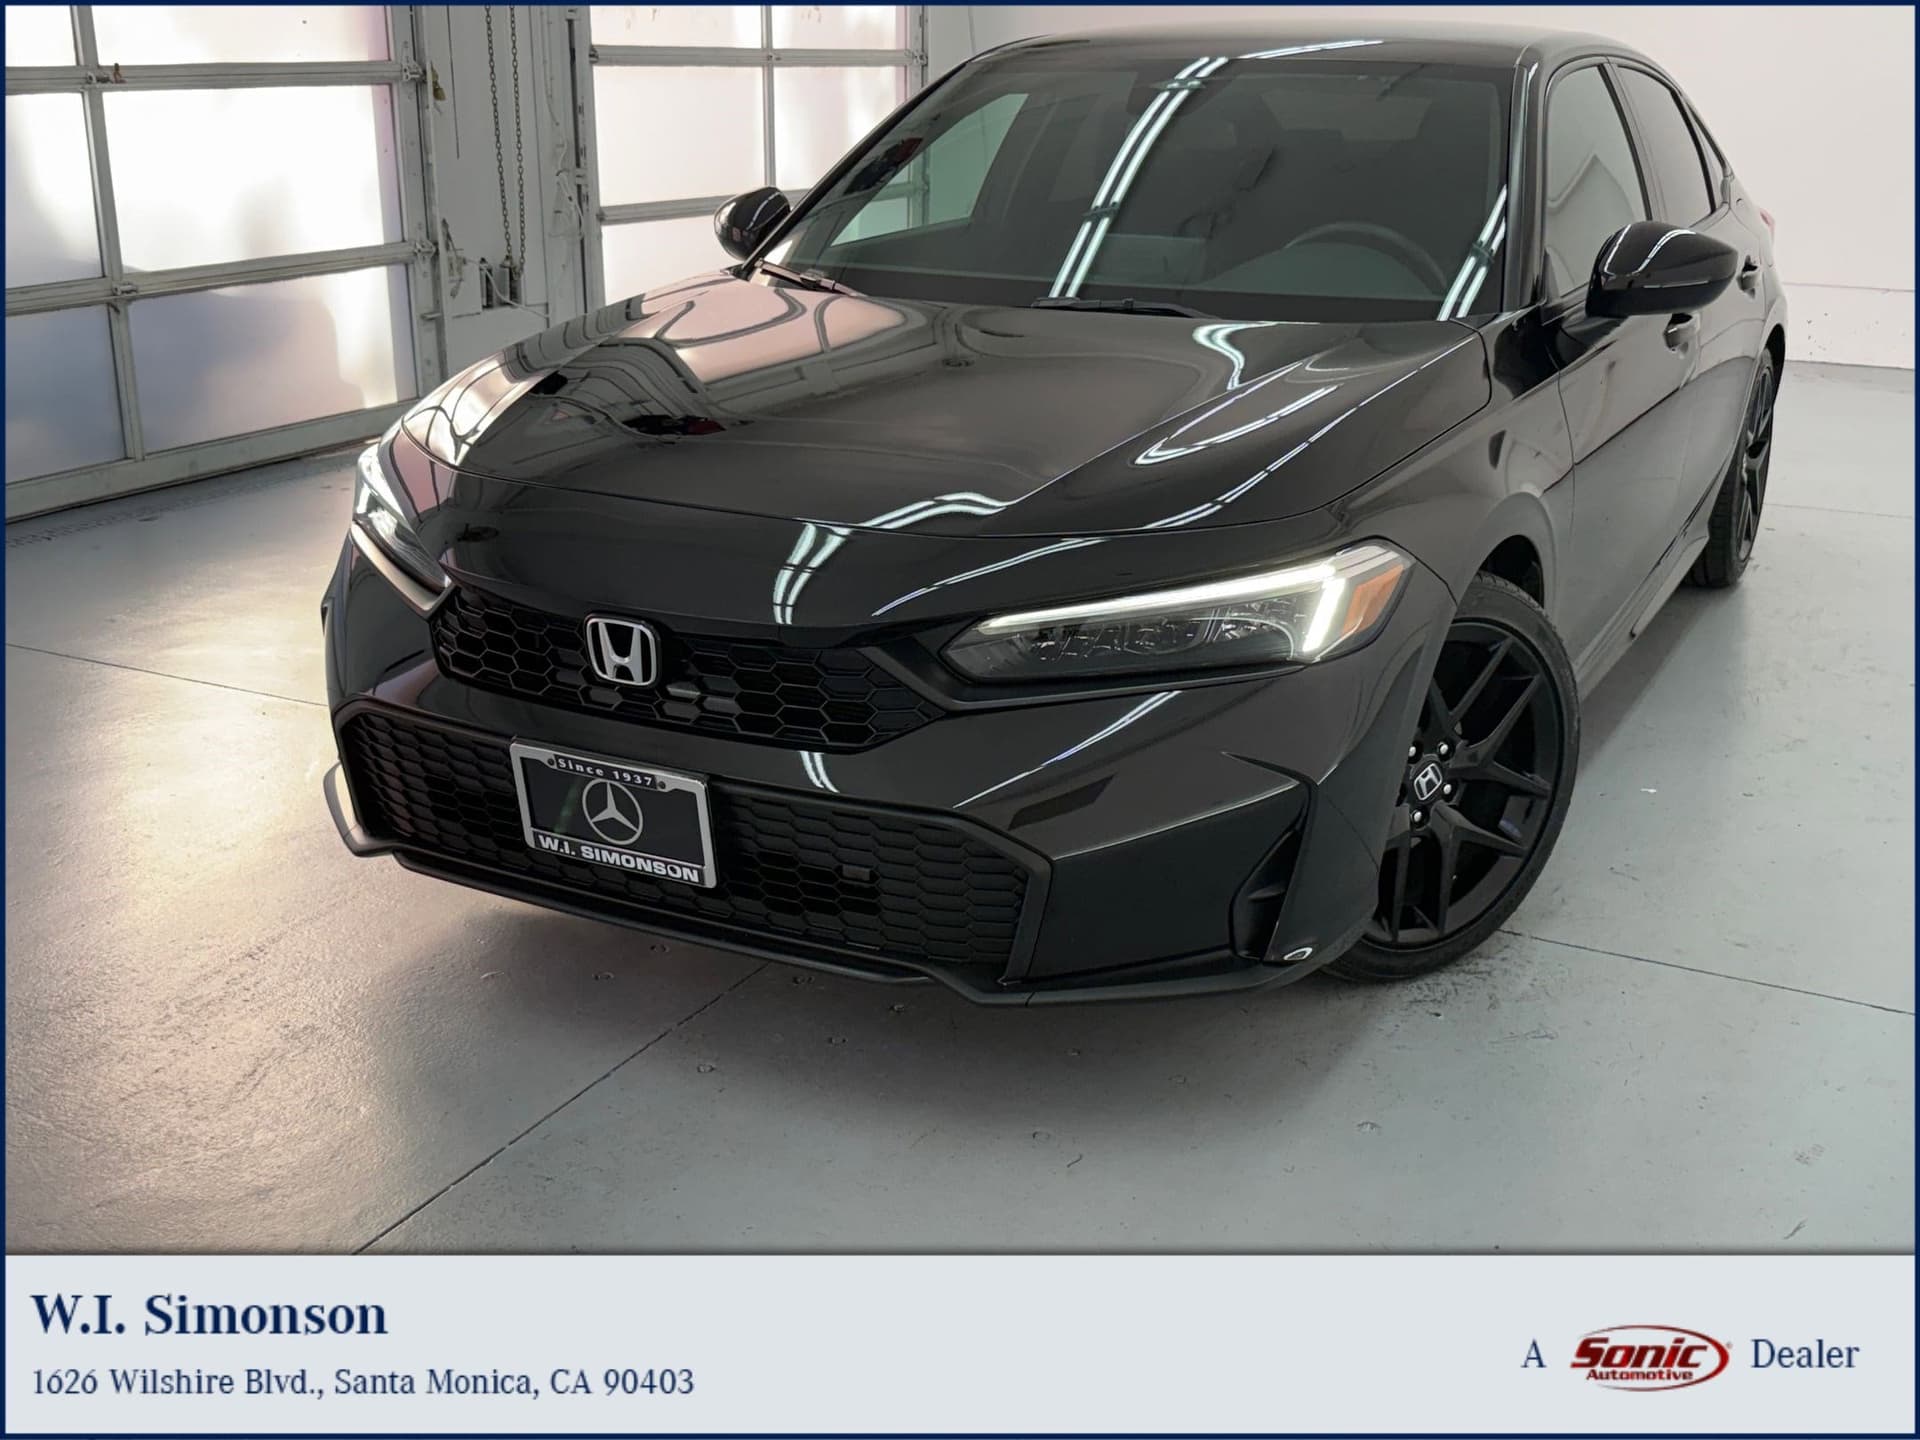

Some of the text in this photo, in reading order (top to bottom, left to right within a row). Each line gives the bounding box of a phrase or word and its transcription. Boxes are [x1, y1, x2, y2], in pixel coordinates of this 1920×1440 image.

[558, 758, 653, 787] Since 1937
[538, 834, 699, 884] W.I. SIMONSON
